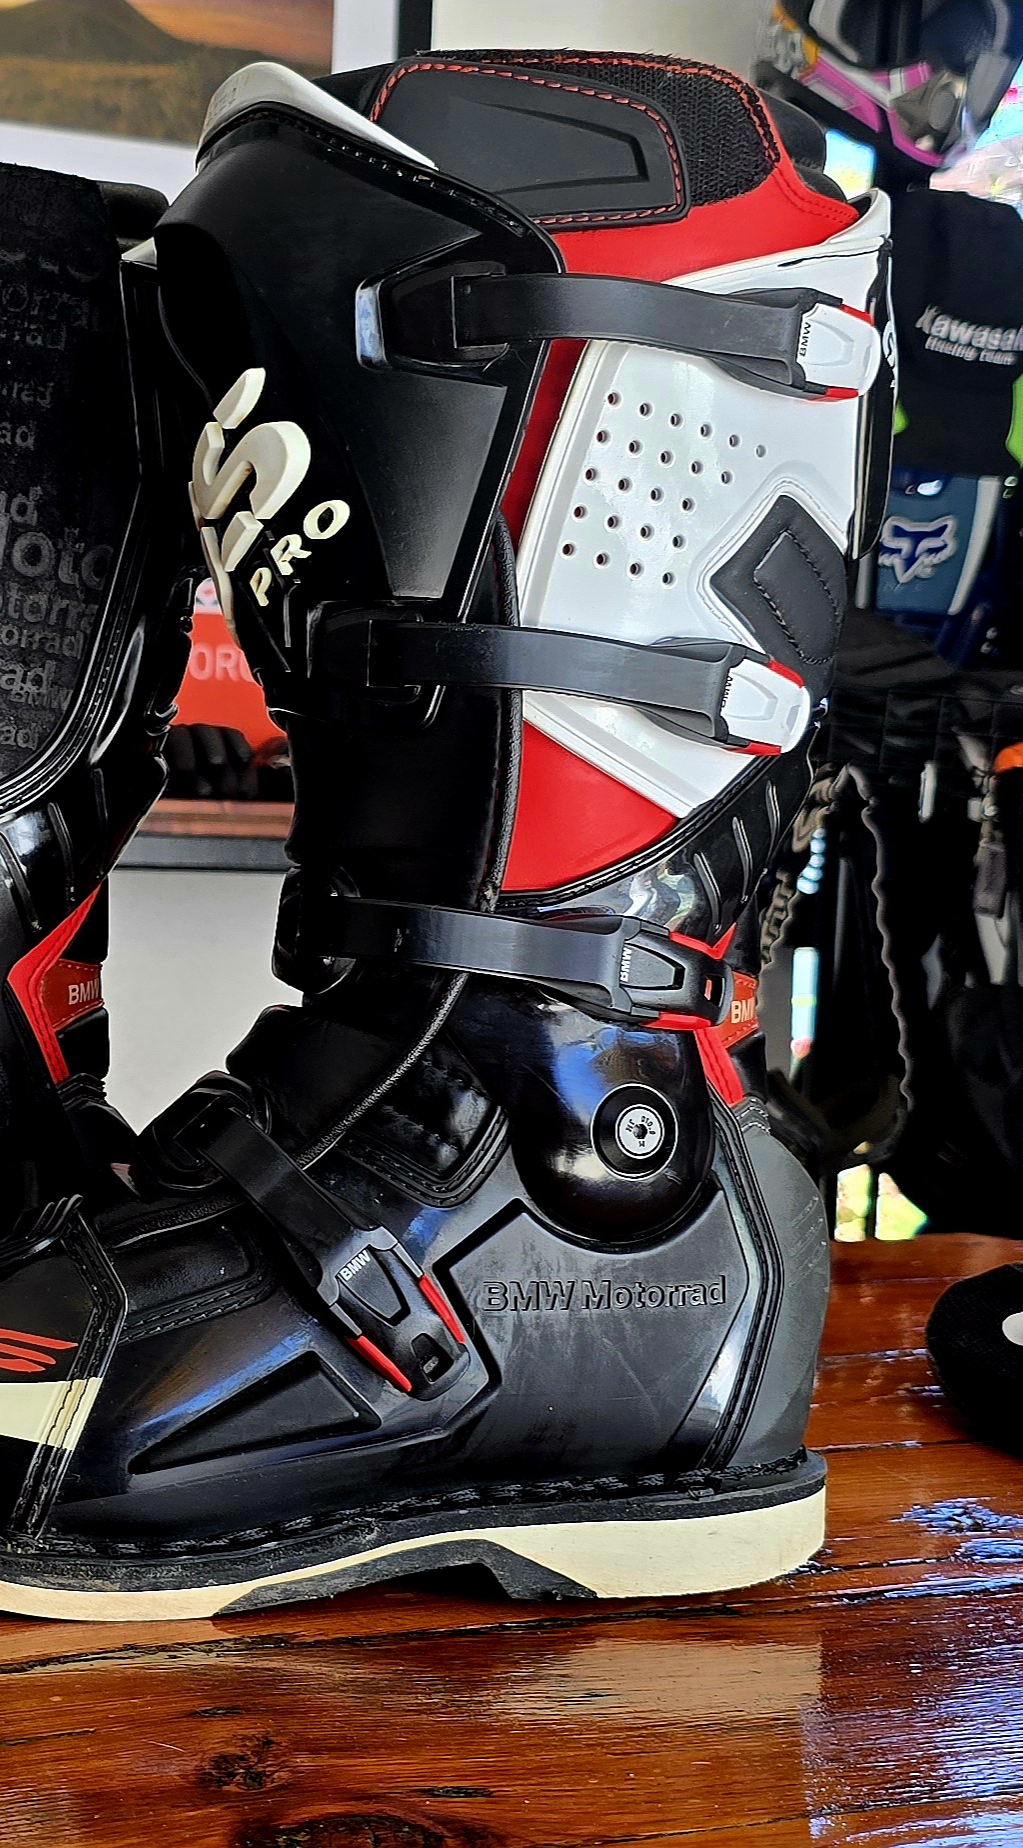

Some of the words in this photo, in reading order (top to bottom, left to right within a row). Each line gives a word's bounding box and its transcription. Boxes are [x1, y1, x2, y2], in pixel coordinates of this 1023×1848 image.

[249, 499, 351, 607] PRO
[339, 1248, 372, 1281] BMW
[483, 1280, 577, 1312] BMW
[580, 1274, 728, 1310] Motorrad
